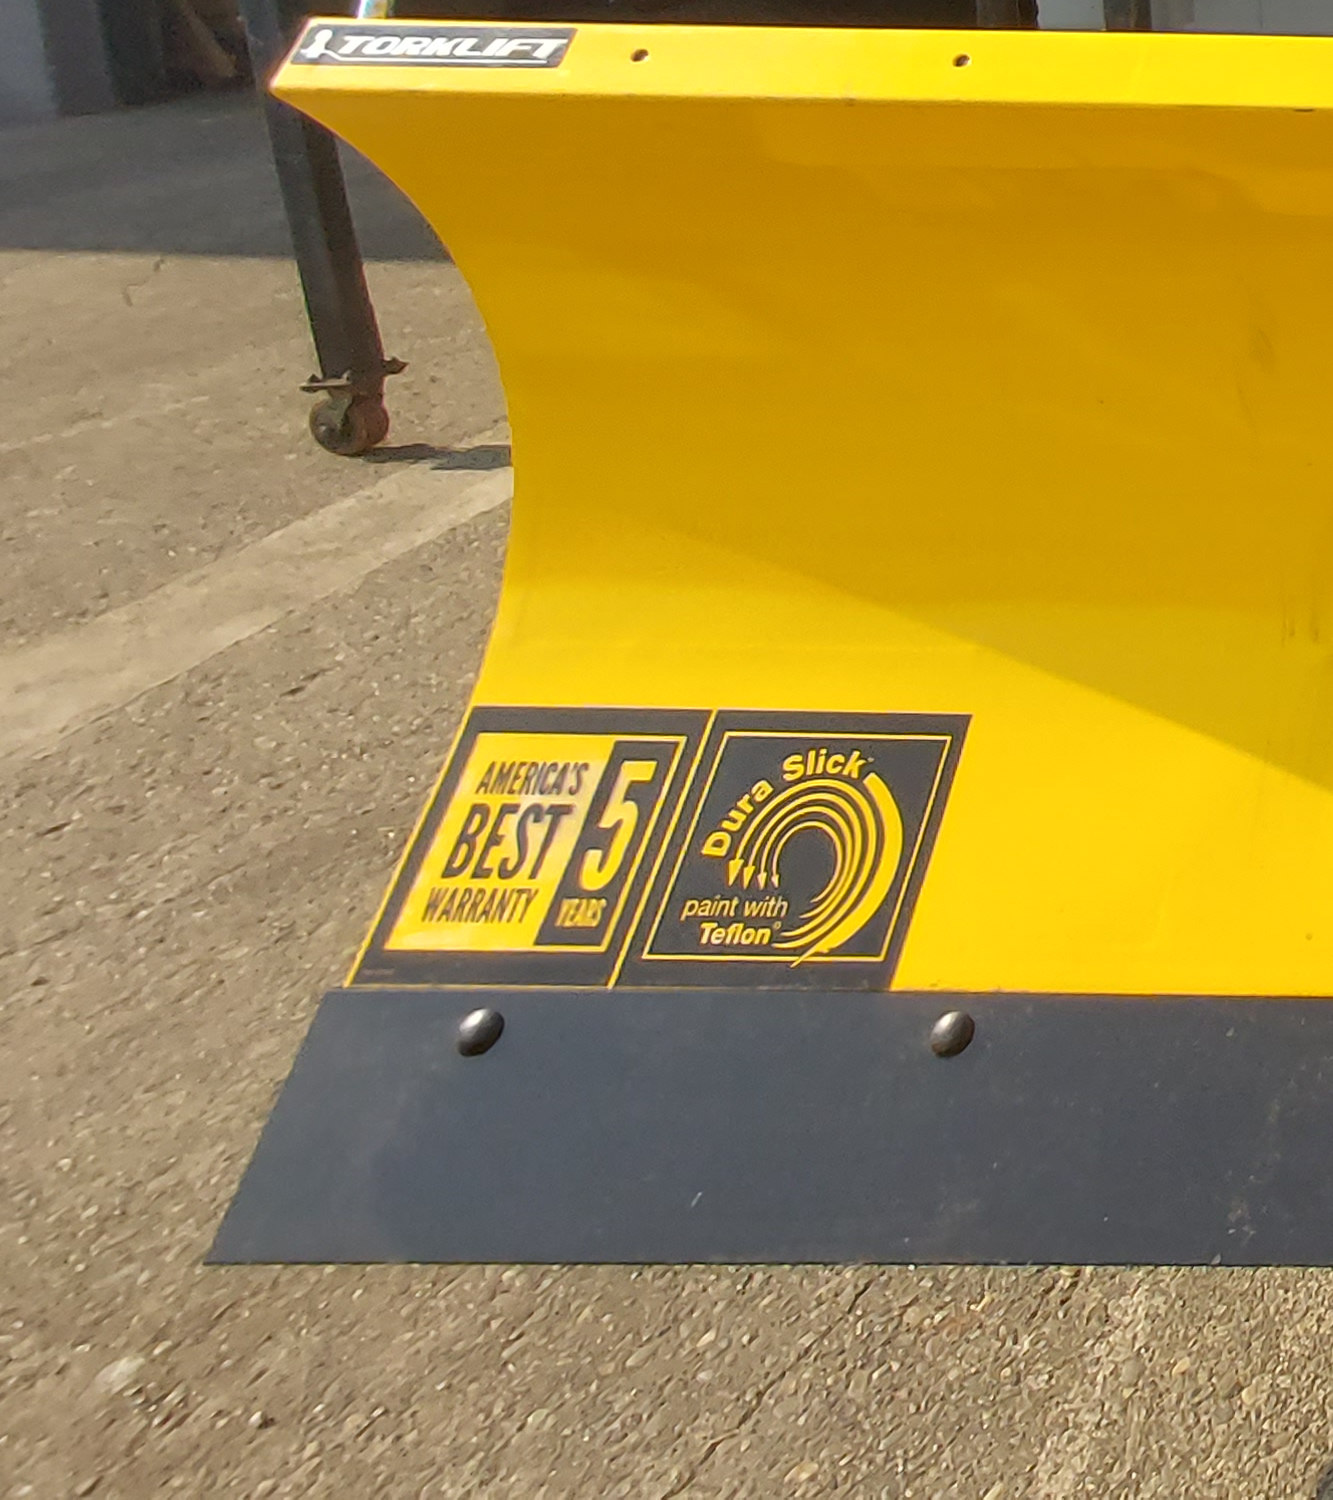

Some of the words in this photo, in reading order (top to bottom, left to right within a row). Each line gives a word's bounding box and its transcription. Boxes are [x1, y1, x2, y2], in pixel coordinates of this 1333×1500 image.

[336, 34, 568, 59] TORKLIFT
[475, 760, 590, 796] AMERICA'S
[701, 779, 774, 857] Dura
[782, 747, 867, 781] Slick
[441, 802, 576, 881] BEST
[579, 759, 658, 891] 5
[421, 886, 540, 924] WARRANTY
[554, 897, 608, 928] YEARS
[680, 894, 739, 921] paint
[744, 894, 789, 918] with
